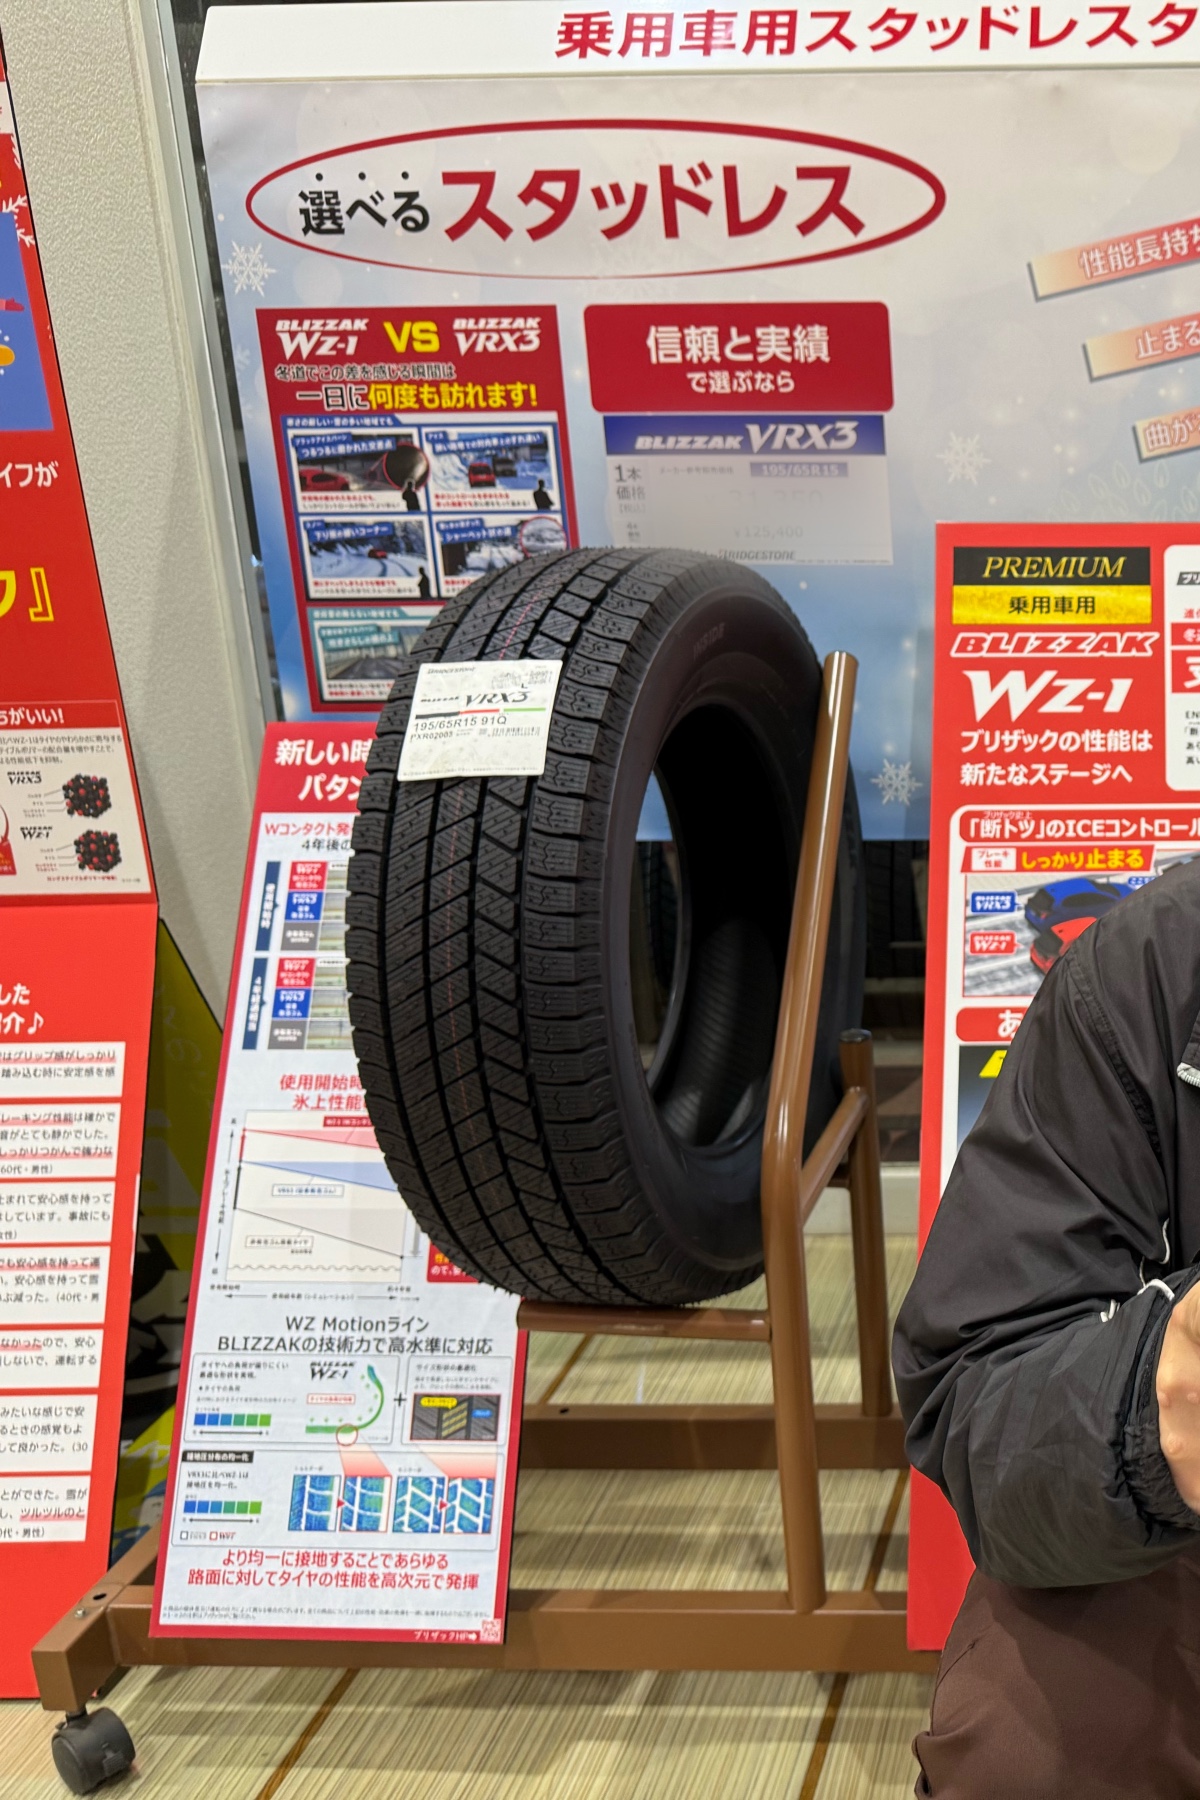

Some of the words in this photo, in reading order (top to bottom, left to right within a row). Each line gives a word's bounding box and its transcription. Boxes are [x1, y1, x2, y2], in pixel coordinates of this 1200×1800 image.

[275, 318, 369, 332] BLIZZAK
[383, 321, 441, 354] VS
[452, 317, 542, 331] BLIZZAK
[454, 330, 542, 357] VRX3
[646, 324, 831, 365] 信頼と実績
[277, 332, 358, 361] WZ-1
[686, 371, 796, 394] で選ぶなら
[634, 435, 744, 450] BLIZZAK
[745, 420, 859, 453] VRX3
[615, 464, 642, 483] 1本
[616, 485, 646, 501] 価格
[981, 556, 1127, 578] PREMIUM
[1008, 596, 1097, 615] 乗用車用
[950, 631, 1160, 658] BLIZZAK
[961, 669, 1134, 723] WZ-1
[413, 718, 478, 732] 195/65R15
[480, 715, 507, 727] 91Q
[960, 729, 1154, 755] ブリザックの性能は
[960, 762, 1133, 787] 新たなステージへ
[265, 822, 354, 838] Wコンタクト発
[1020, 848, 1145, 870] しっかり止まる
[292, 1094, 367, 1112] 氷上性能
[0, 1111, 116, 1124] レーキング性能は確かで
[286, 1316, 317, 1332] WZ
[322, 1315, 430, 1333] Motionライン
[217, 1335, 494, 1355] BLIZZAKの技術力で高水準に対応
[0, 1354, 97, 1367] しないで、運転する
[221, 1550, 450, 1571] より均一に接地することであらゆる
[187, 1570, 480, 1591] 路面に対してタイヤの性能を高次元で発揮
